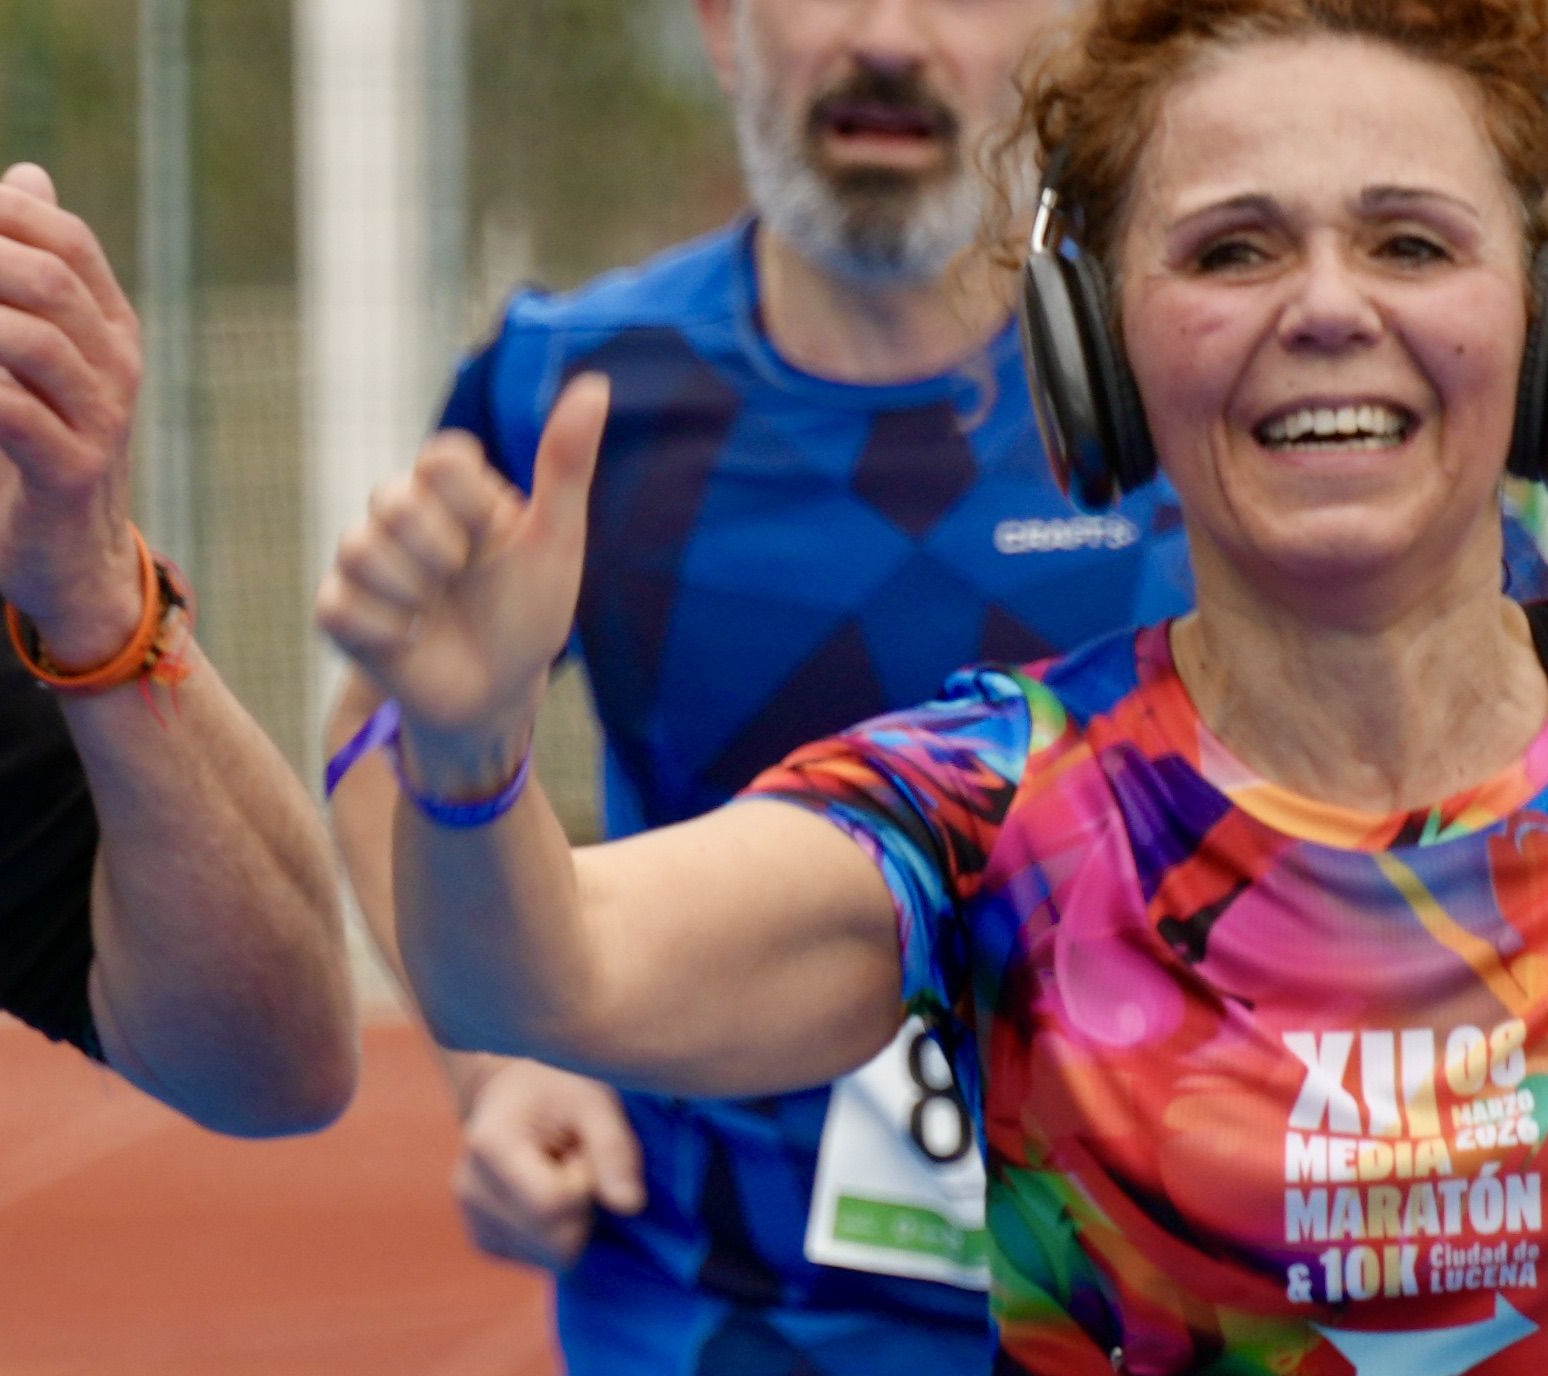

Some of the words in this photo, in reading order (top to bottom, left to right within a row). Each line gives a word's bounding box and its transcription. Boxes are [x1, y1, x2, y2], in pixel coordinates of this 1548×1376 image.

[1282, 1028, 1442, 1138] XII
[1445, 1018, 1528, 1096] 08
[1451, 1088, 1535, 1128] MARZO
[1285, 1132, 1453, 1183] MEDIA
[1285, 1162, 1542, 1242] MARATÓN
[1287, 1263, 1312, 1304] &
[1319, 1244, 1420, 1303] 10K
[1430, 1241, 1508, 1268] Ciudad
[1512, 1240, 1539, 1261] de
[1430, 1261, 1538, 1295] LUCENA
